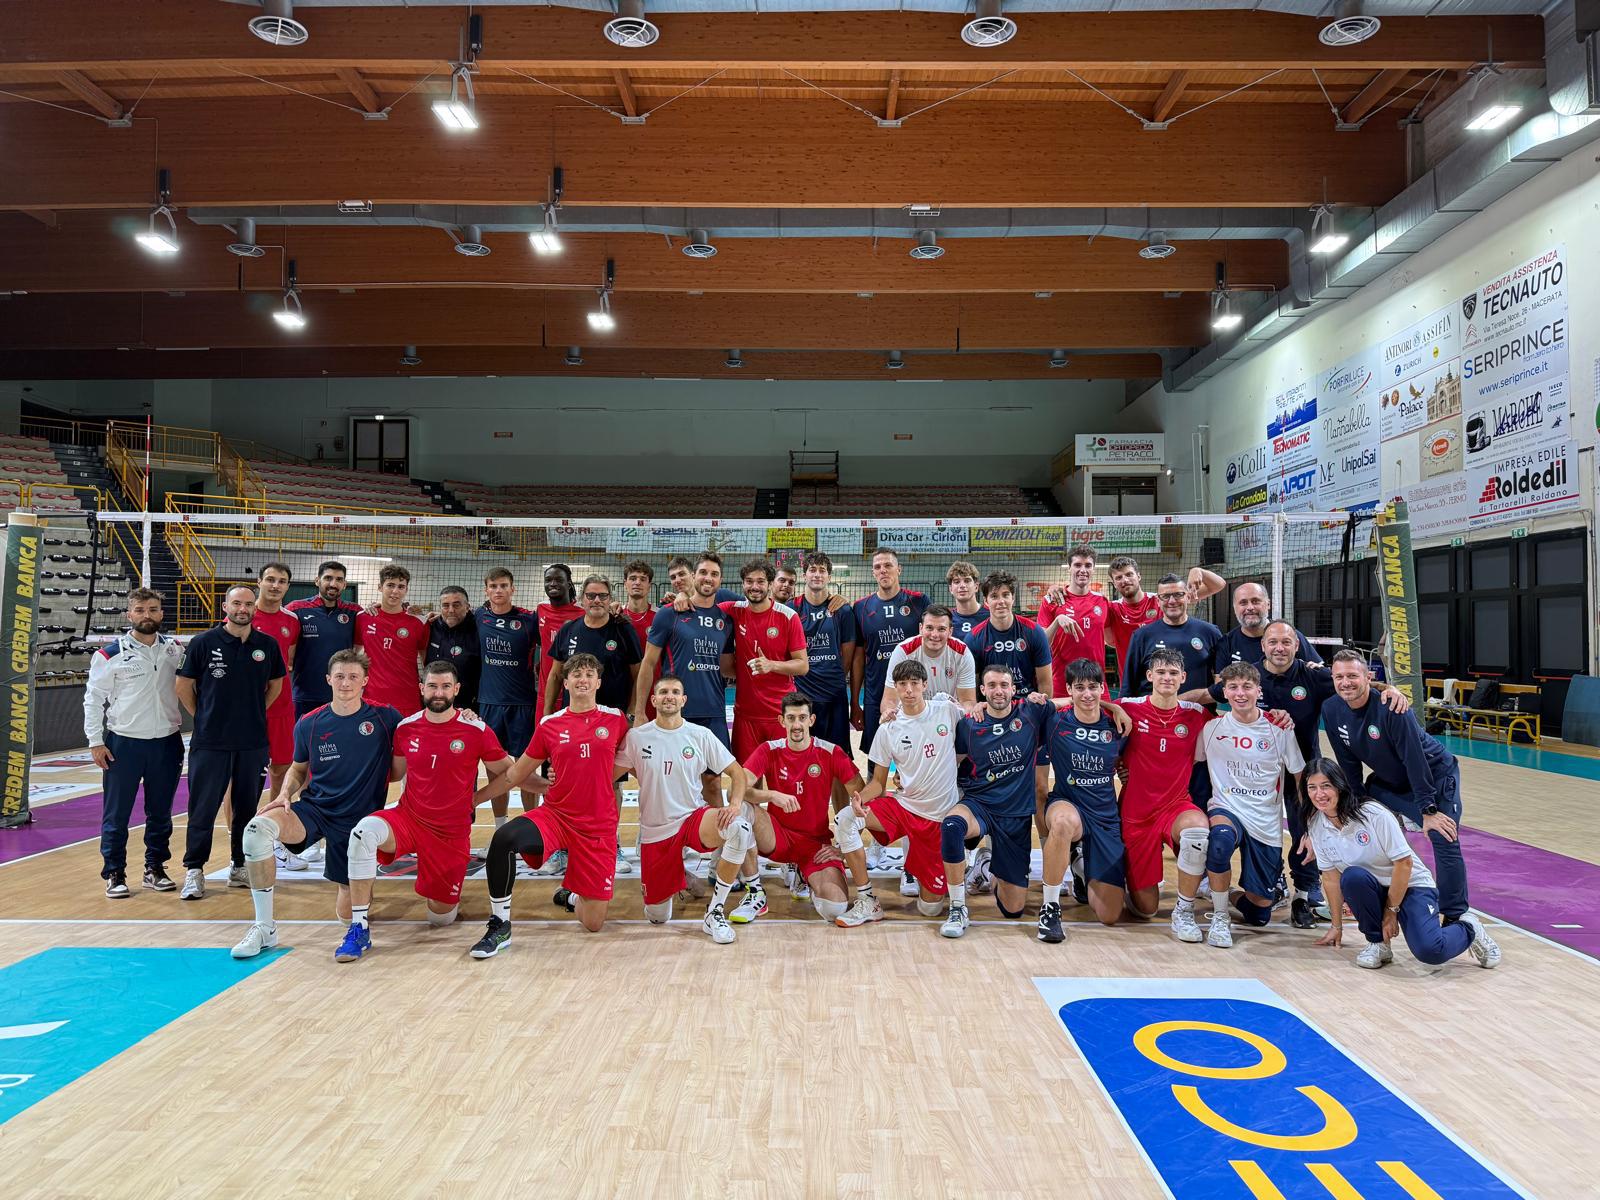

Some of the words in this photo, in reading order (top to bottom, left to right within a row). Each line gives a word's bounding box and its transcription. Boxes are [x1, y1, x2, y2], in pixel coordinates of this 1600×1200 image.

[1482, 275, 1511, 297] VENDITA
[1512, 249, 1558, 281] ASSISTENZA
[1483, 261, 1563, 319] TECNAUTO
[1531, 290, 1563, 311] MACERATA
[1384, 338, 1412, 363] ANTINORI
[1421, 311, 1452, 344] ASSIFIN
[1463, 318, 1564, 379] SERIPRINCE
[1402, 356, 1422, 371] ZURICH
[1478, 361, 1549, 396] www.seriprince.it
[1398, 399, 1424, 418] Palace
[1237, 445, 1267, 479] iColli
[1341, 449, 1376, 476] UnipolSai
[1494, 456, 1534, 475] IMPRESA
[1538, 445, 1567, 463] EDILE
[1493, 458, 1567, 500] Roldedil
[1479, 504, 1487, 514] di
[880, 532, 904, 542] Diva
[906, 531, 924, 542] Car
[975, 528, 1041, 541] DOMIZIOLI
[1071, 527, 1105, 543] tigre
[1108, 527, 1156, 536] colleverde
[16, 536, 38, 598] BANCA
[1382, 535, 1405, 598] BANCA
[810, 610, 824, 621] 16
[883, 605, 895, 618] 11
[495, 618, 506, 629] 2
[697, 616, 714, 628] 18
[961, 622, 972, 633] 8
[1082, 617, 1091, 629] 13
[11, 604, 33, 673] CREDEM
[878, 627, 904, 638] EMMA
[879, 633, 905, 644] VILLAS
[383, 637, 393, 650] 27
[693, 639, 718, 649] EMMA
[994, 641, 1015, 653] 99
[1389, 605, 1413, 675] CREDEM
[486, 643, 512, 654] VILLAS
[931, 666, 937, 677] 1
[9, 683, 29, 744] BANCA
[992, 723, 1004, 736] 5
[1075, 728, 1099, 742] 95
[1159, 738, 1167, 753] 8
[1231, 736, 1253, 750] 10
[580, 743, 591, 759] 31
[924, 743, 936, 759] 22
[988, 745, 1021, 760] EMMA
[1071, 752, 1105, 764] EMMA
[431, 754, 437, 769] 7
[989, 751, 1023, 766] VILLAS
[1071, 759, 1105, 772] VILLAS
[664, 761, 673, 775] 17
[1226, 769, 1262, 779] VILLAS
[796, 781, 804, 795] 15
[1075, 776, 1110, 786] CODYECO
